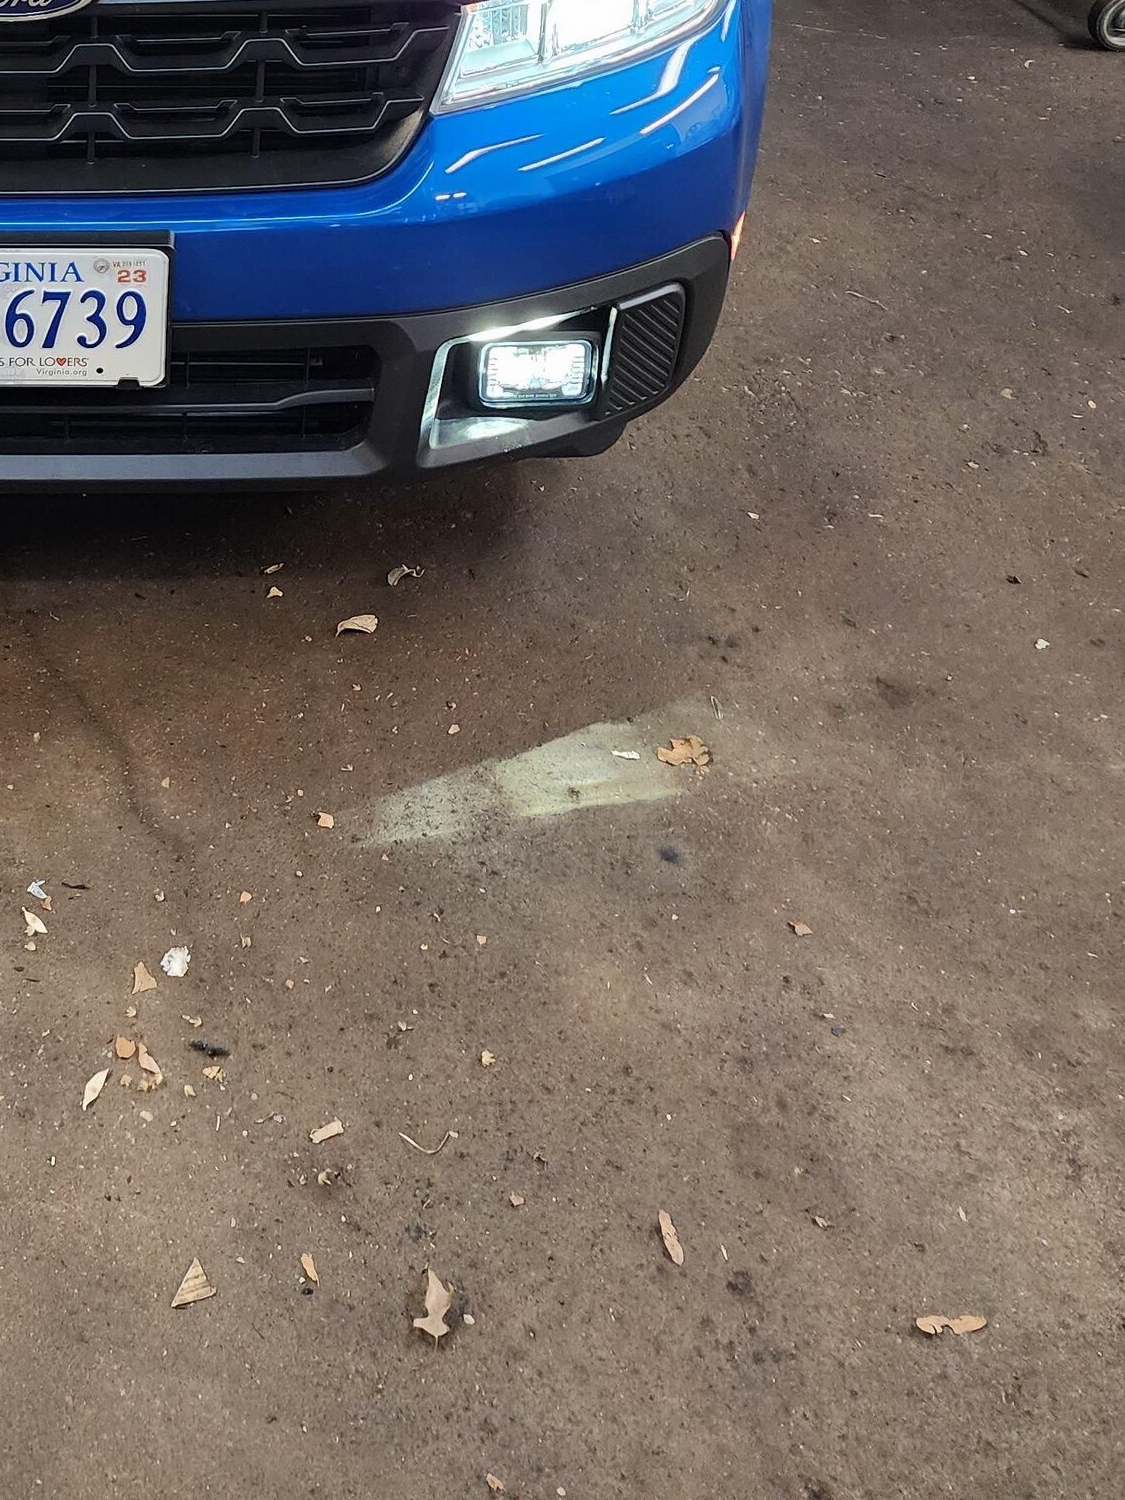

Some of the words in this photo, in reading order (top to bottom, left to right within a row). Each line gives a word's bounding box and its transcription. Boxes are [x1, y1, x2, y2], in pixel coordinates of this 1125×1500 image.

[117, 269, 148, 284] 23
[8, 356, 37, 368] FOR
[36, 368, 88, 377] Virginia.org
